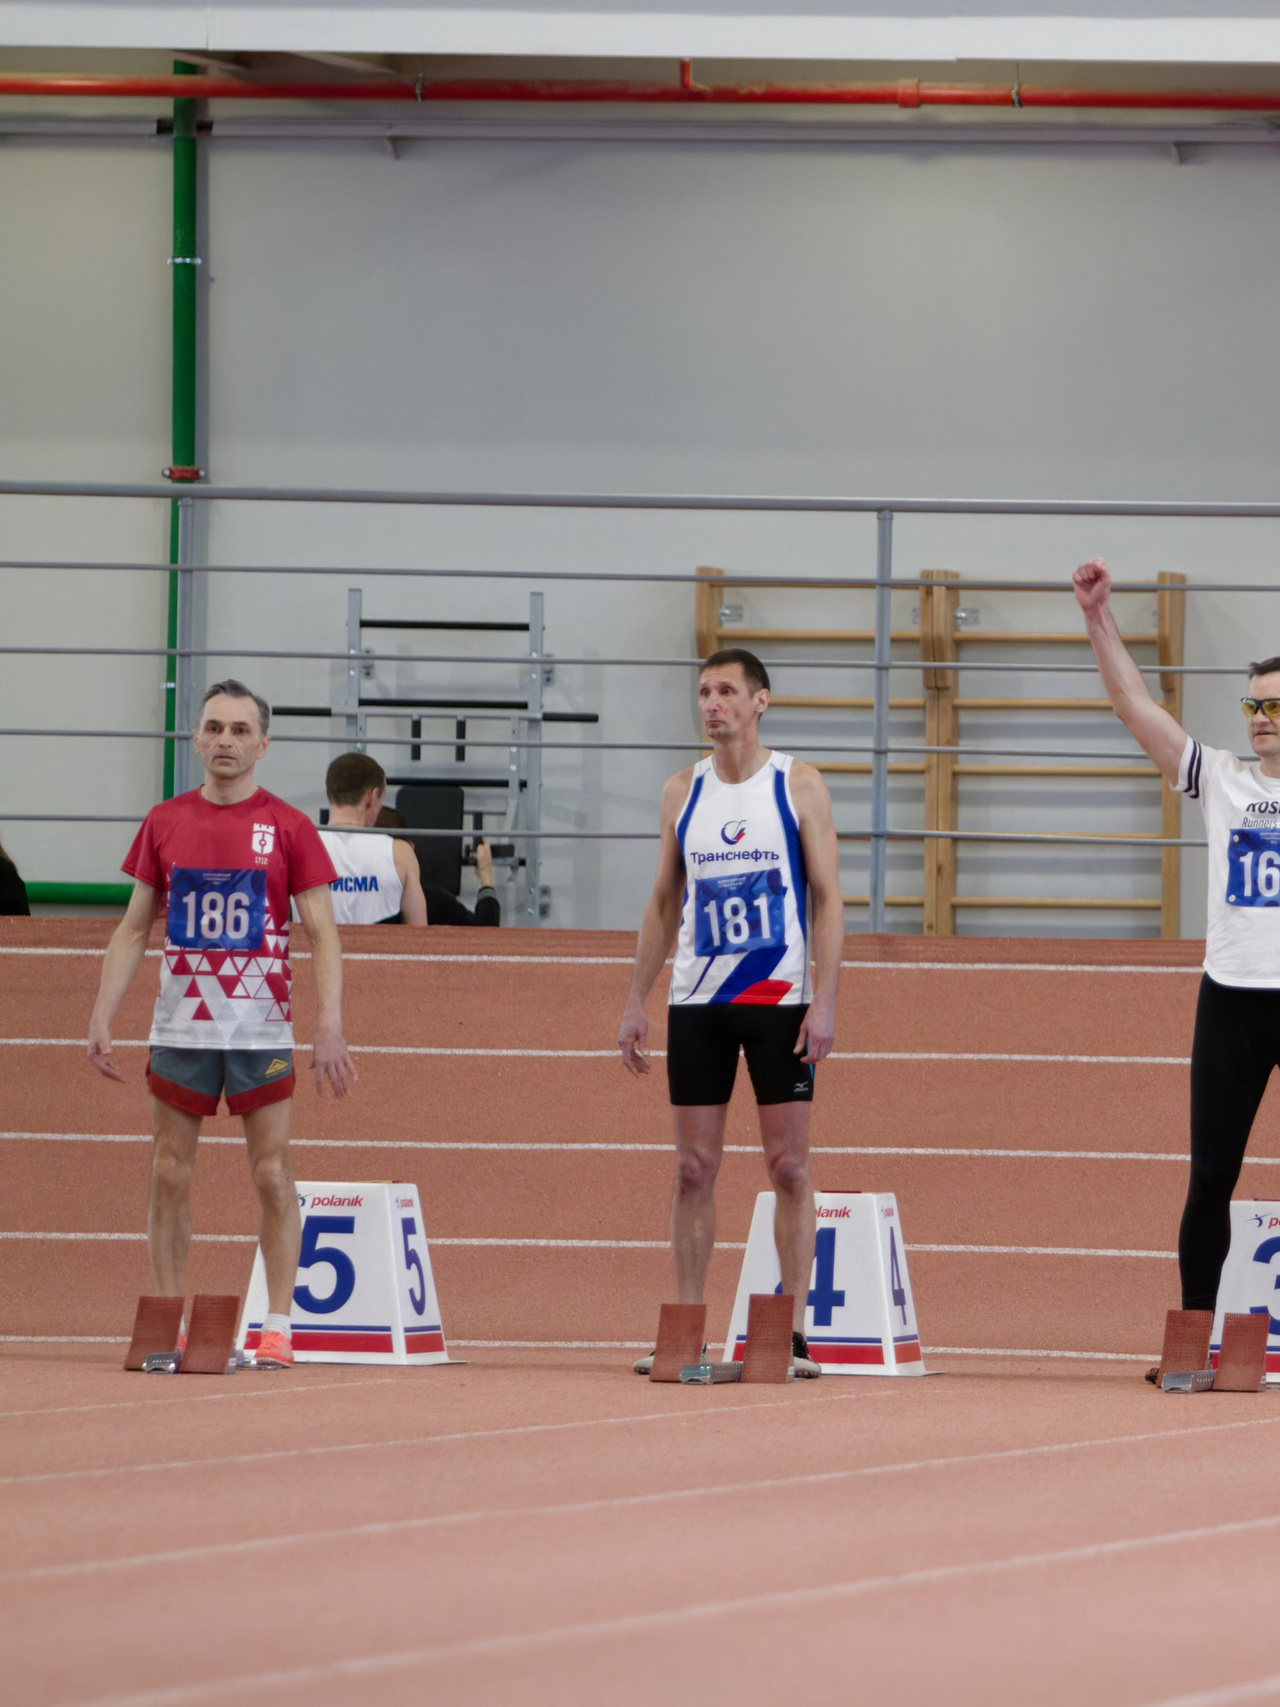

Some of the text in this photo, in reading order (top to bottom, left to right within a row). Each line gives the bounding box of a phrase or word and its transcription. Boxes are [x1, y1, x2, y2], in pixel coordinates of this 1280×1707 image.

[254, 856, 268, 866] 1712
[690, 848, 779, 864] Транснефть
[328, 875, 379, 892] ИСМА
[182, 891, 250, 939] 186
[703, 893, 771, 947] 181
[310, 1194, 364, 1209] polanik
[814, 1205, 851, 1219] lanik
[293, 1215, 356, 1315] 5
[401, 1217, 426, 1316] 5
[890, 1226, 907, 1326] 4
